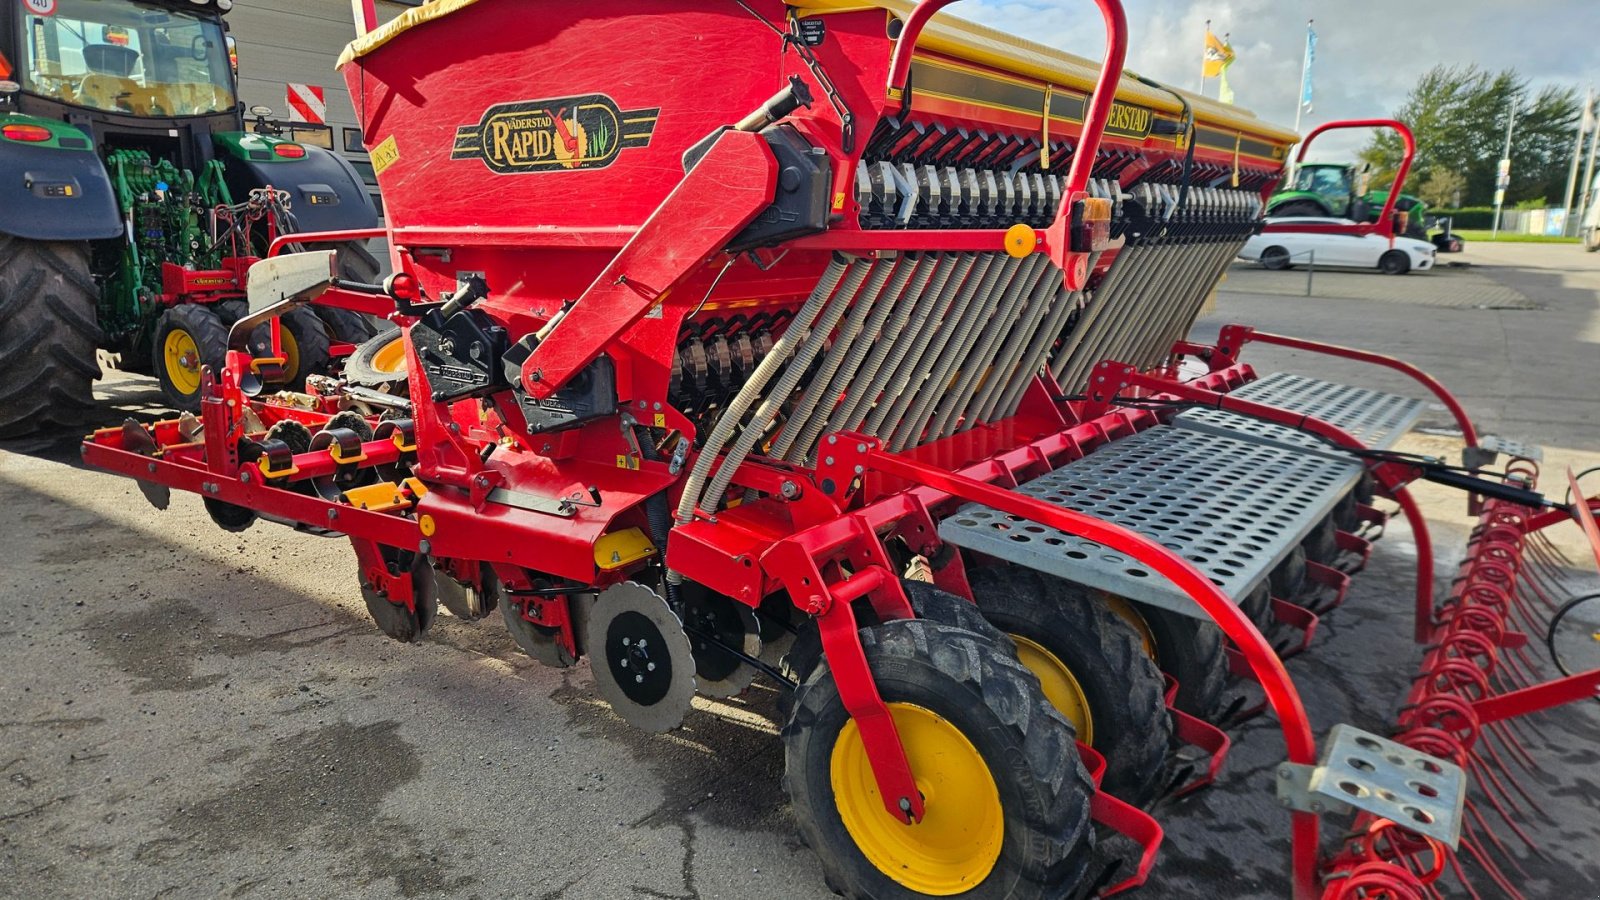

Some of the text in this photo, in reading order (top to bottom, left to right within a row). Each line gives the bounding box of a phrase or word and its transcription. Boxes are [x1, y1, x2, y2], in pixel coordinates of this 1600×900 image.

[506, 116, 552, 130] VÄDERSTAD
[1107, 103, 1148, 132] ERSTAD
[492, 120, 552, 166] RAPID
